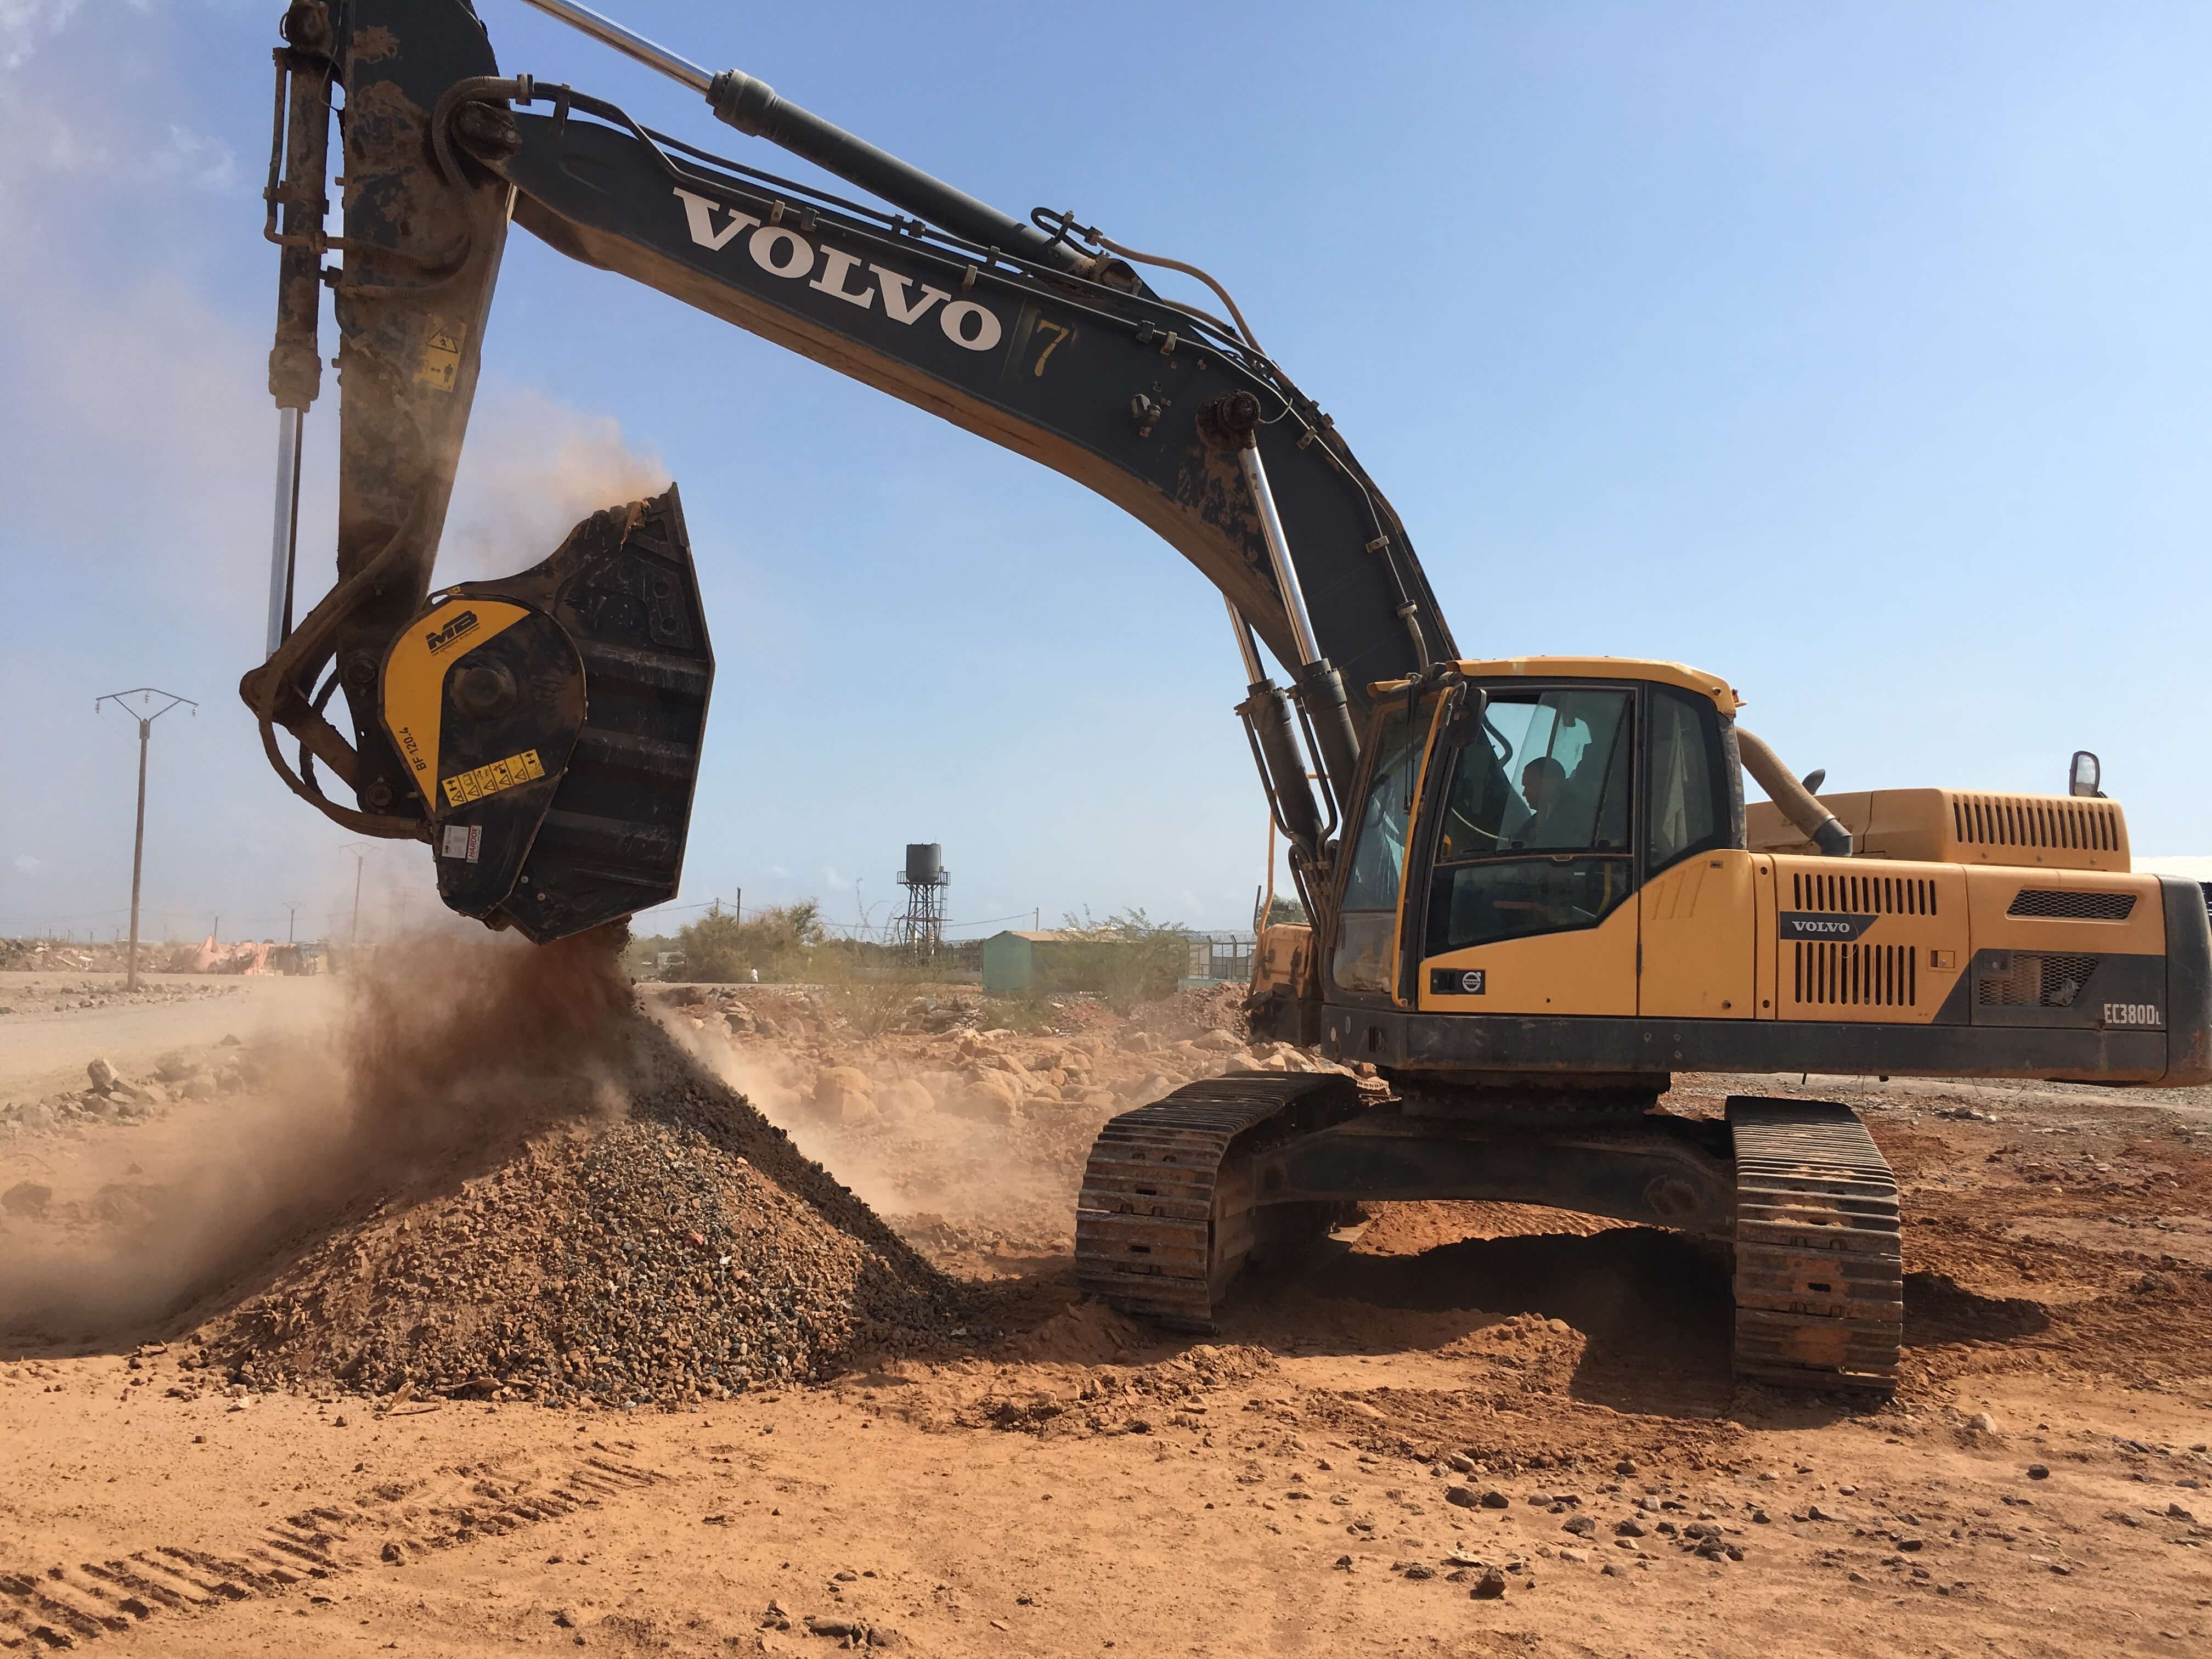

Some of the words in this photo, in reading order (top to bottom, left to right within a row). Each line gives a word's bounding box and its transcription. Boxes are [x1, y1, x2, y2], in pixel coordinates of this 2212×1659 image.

[673, 187, 1002, 351] VOLVO
[1035, 319, 1069, 377] 7
[425, 610, 478, 651] MB
[399, 727, 419, 754] 120.4
[412, 757, 427, 771] BF
[469, 828, 478, 858] HARDOX
[1792, 921, 1850, 933] VOLVO
